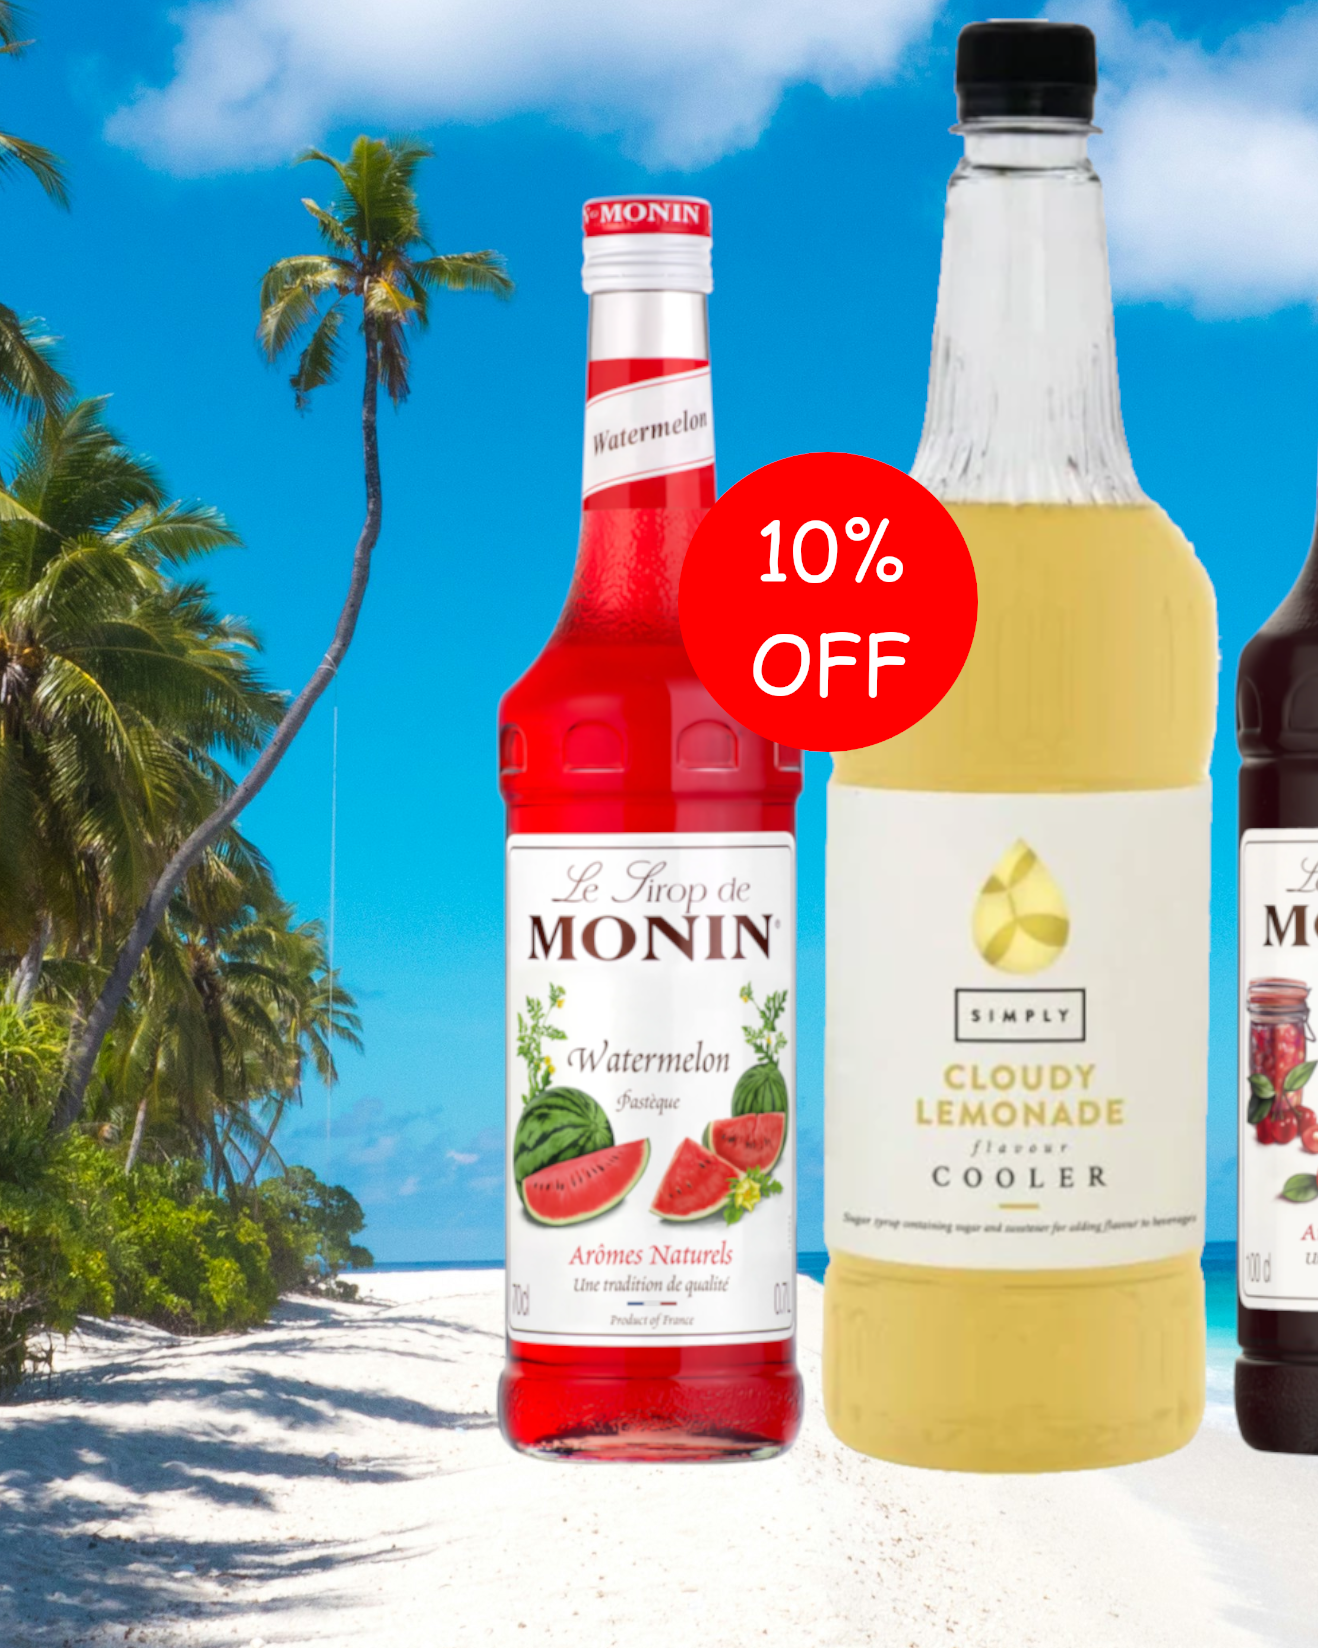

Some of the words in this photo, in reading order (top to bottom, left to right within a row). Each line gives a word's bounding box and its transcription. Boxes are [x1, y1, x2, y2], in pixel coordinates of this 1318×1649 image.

[600, 202, 700, 225] MONIN
[592, 409, 708, 457] Watermelon
[551, 861, 603, 903] Le
[611, 860, 707, 914] Sirop
[718, 877, 751, 903] de
[970, 1008, 1070, 1023] SIMPLY
[567, 1039, 730, 1074] Watermelon
[943, 1064, 1096, 1091] CLOUDY
[615, 1089, 681, 1116] Pastèque
[916, 1098, 1125, 1127] LEMONADE
[970, 1140, 1070, 1157] flavour
[932, 1165, 1106, 1189] COOLER
[843, 1211, 872, 1227] Sugar
[984, 1223, 1002, 1233] and
[568, 1243, 643, 1265] Arômes
[649, 1240, 733, 1265] Naturels
[573, 1277, 600, 1293] Une
[602, 1274, 663, 1293] tradition
[666, 1274, 682, 1293] de
[685, 1275, 729, 1298] qualité
[610, 1314, 647, 1326] Product
[649, 1314, 660, 1329] of
[662, 1315, 695, 1326] France
